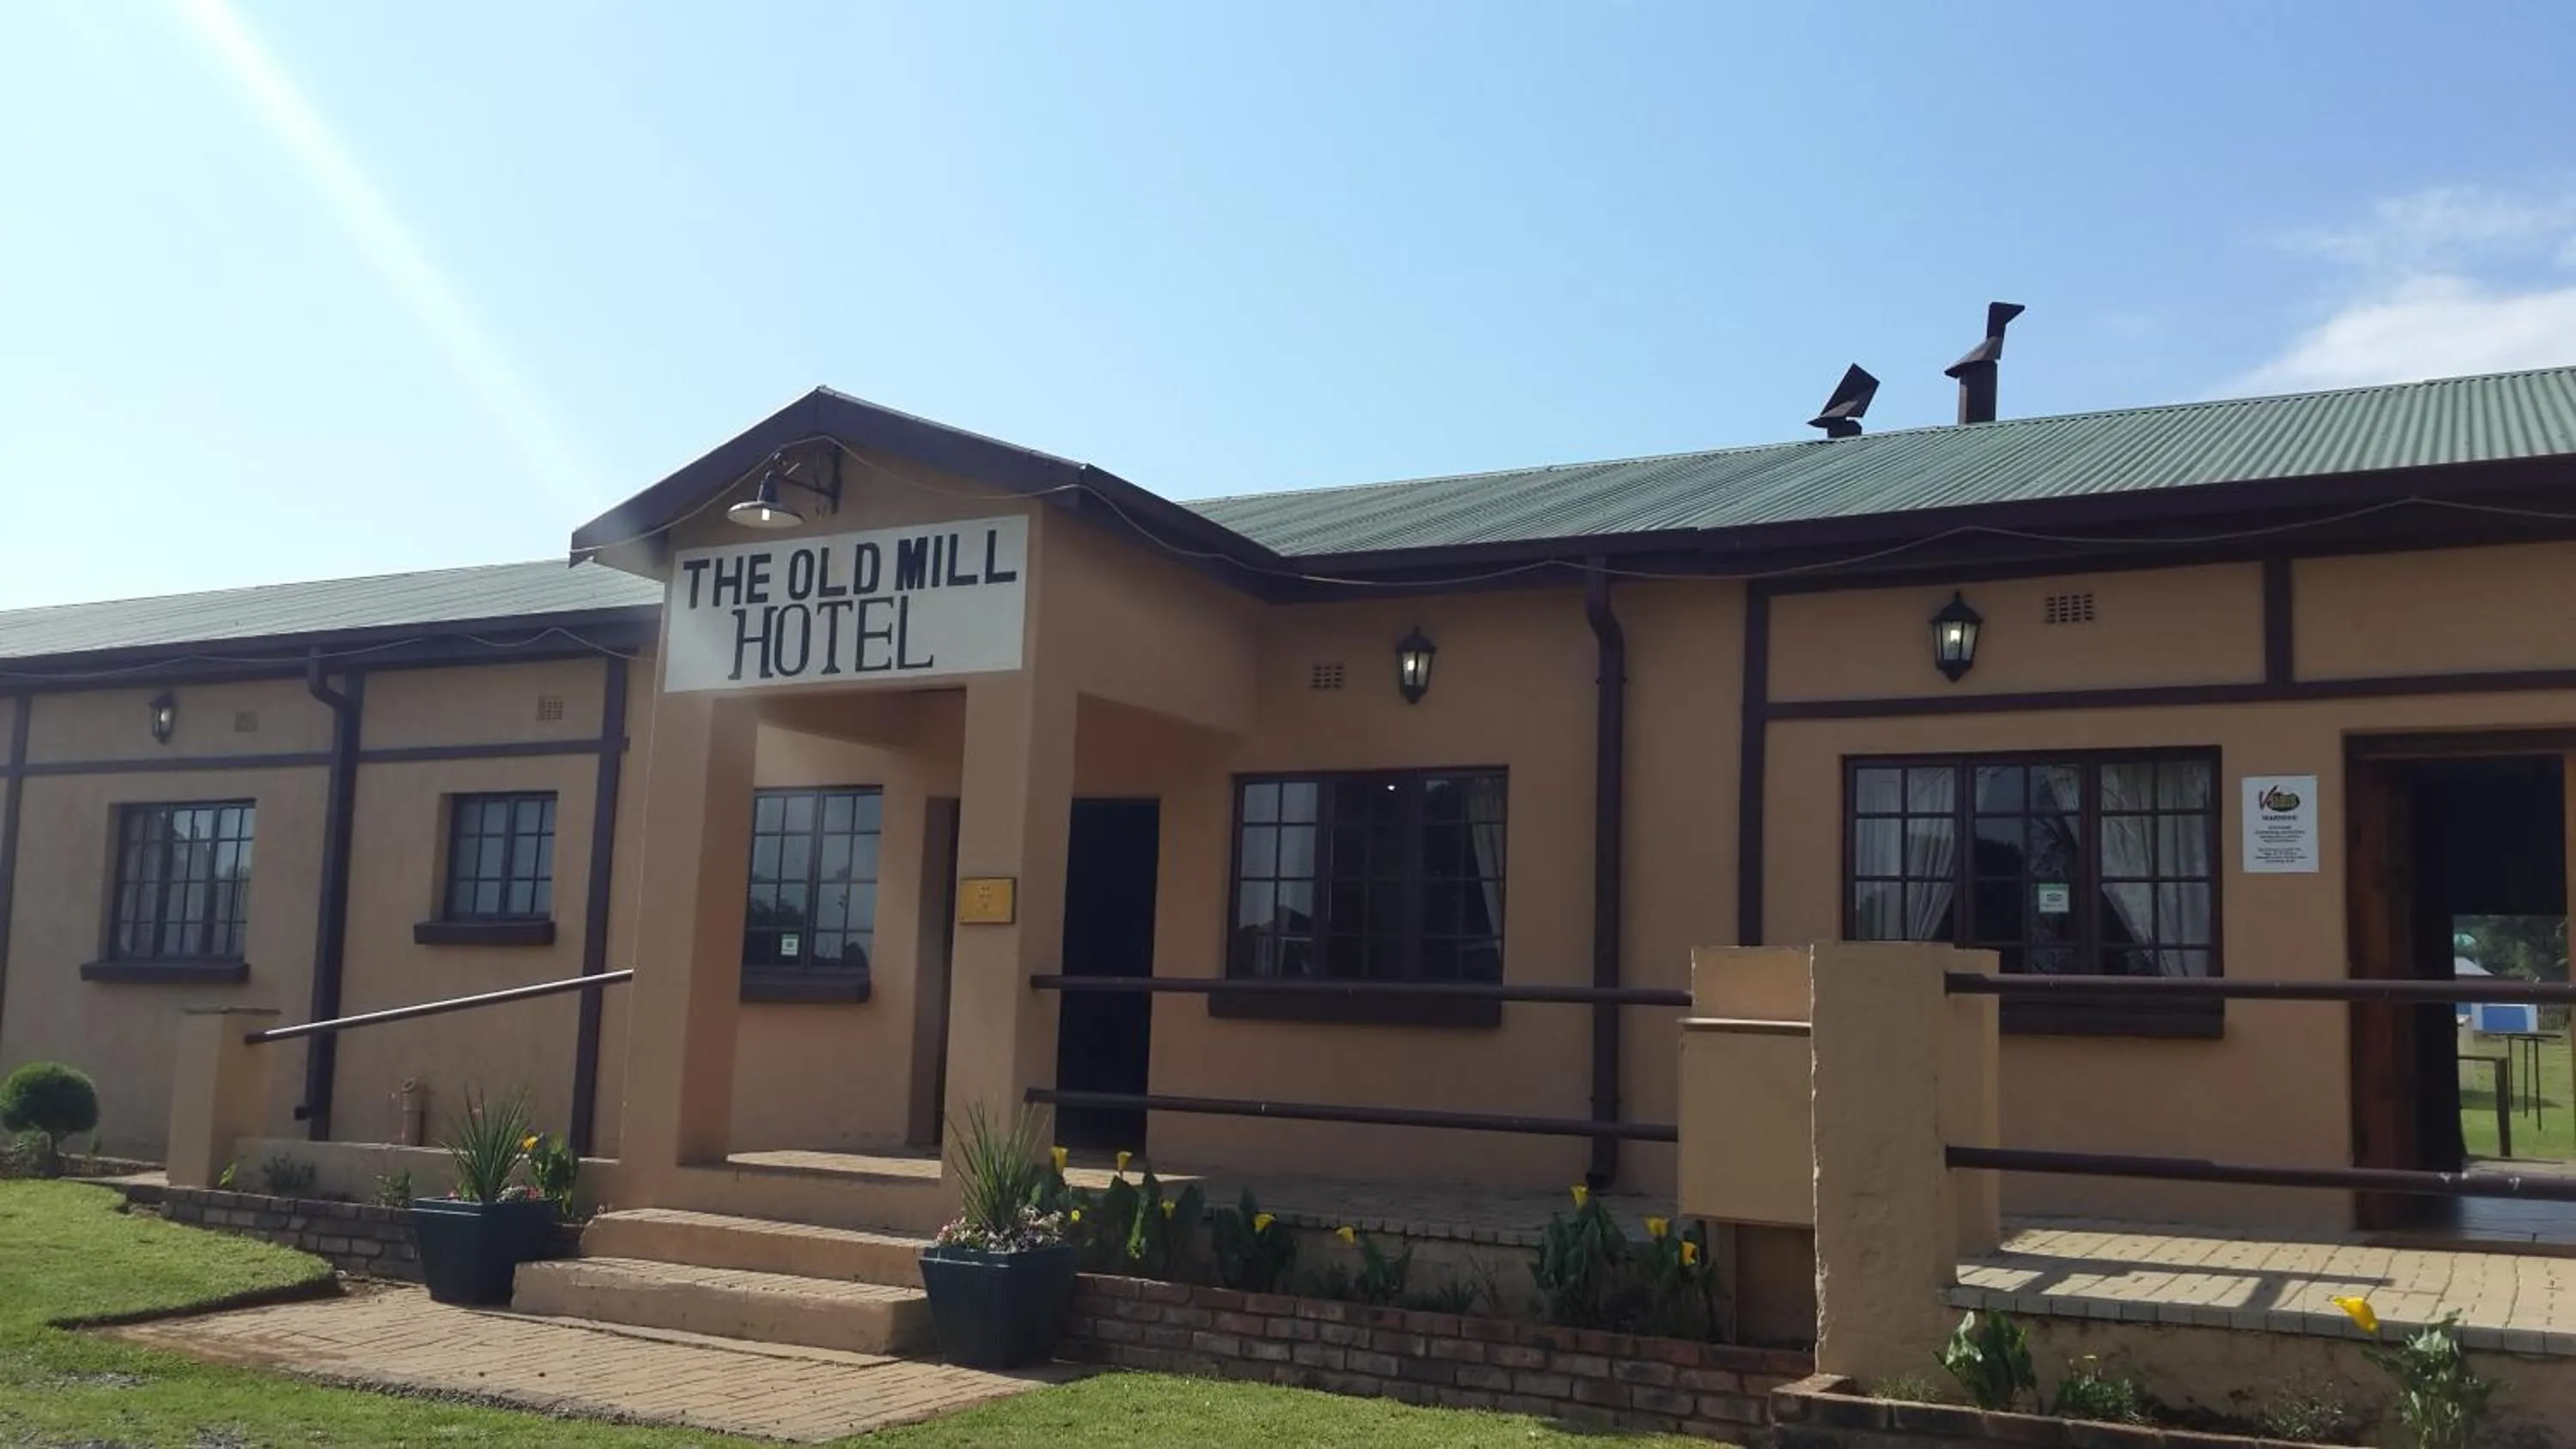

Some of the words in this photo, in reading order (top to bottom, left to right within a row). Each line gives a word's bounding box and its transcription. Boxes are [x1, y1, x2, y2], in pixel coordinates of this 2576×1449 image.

[683, 554, 772, 609] THE
[788, 542, 880, 600] OLD
[895, 530, 1017, 591] MILL
[728, 595, 934, 681] HOTEL
